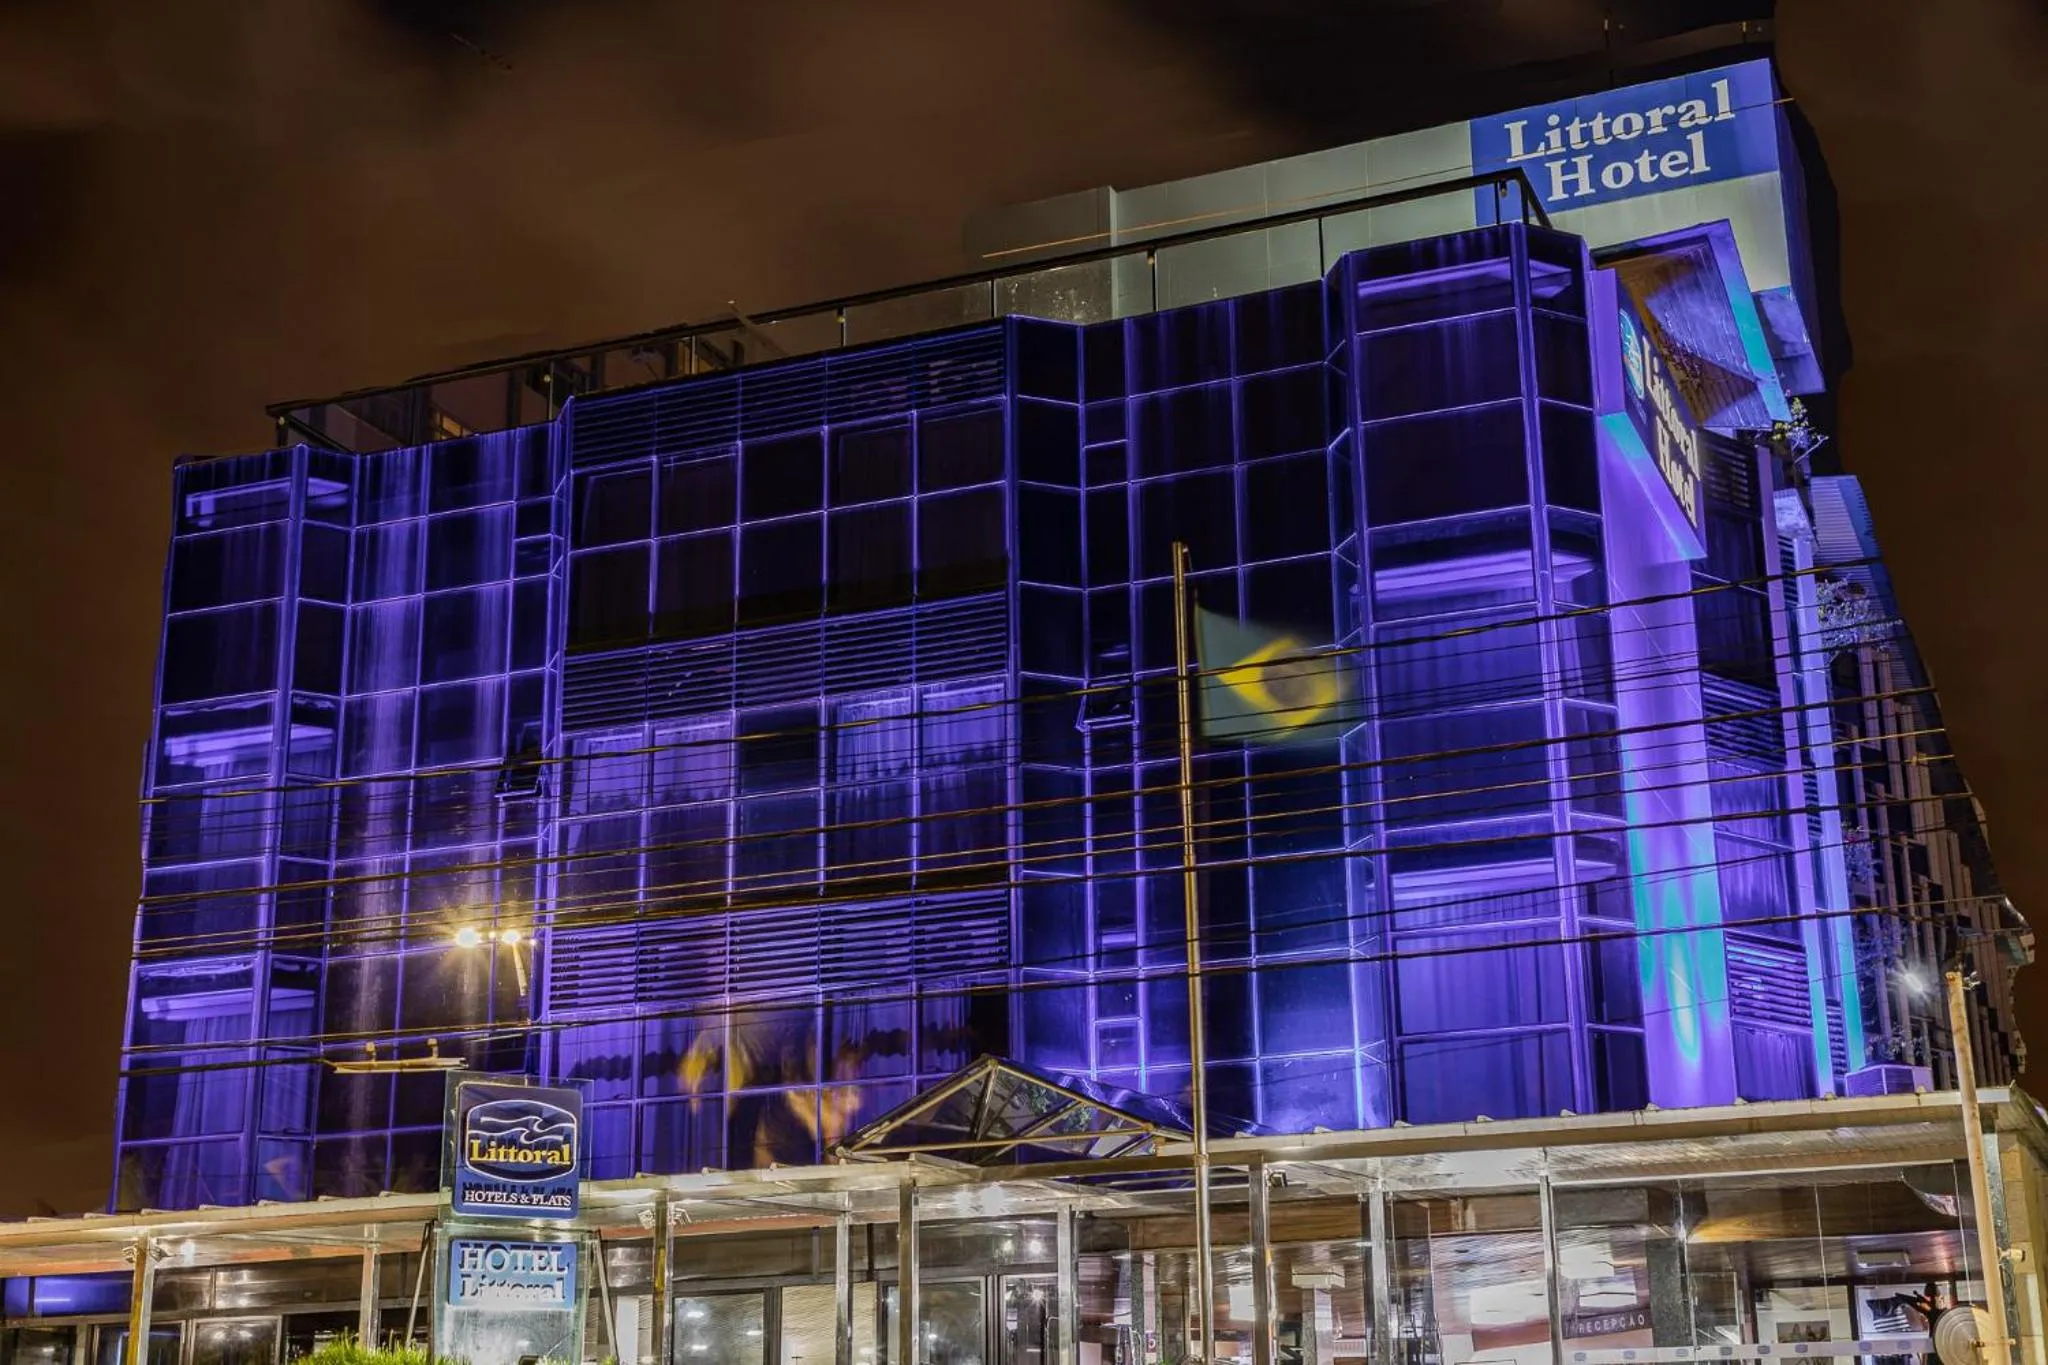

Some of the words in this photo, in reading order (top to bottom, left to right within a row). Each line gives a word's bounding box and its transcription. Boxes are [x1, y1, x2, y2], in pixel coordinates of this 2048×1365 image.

[1504, 79, 1736, 162] Littoral
[1545, 131, 1711, 202] Hotel
[1642, 335, 1701, 481] Littoral
[1655, 415, 1697, 528] Hotel
[470, 1139, 571, 1165] Littoral
[464, 1189, 518, 1204] HOTELS
[519, 1193, 531, 1204] &
[532, 1194, 572, 1207] FLATS
[460, 1246, 568, 1274] HOTEL
[462, 1276, 565, 1302] Littoral
